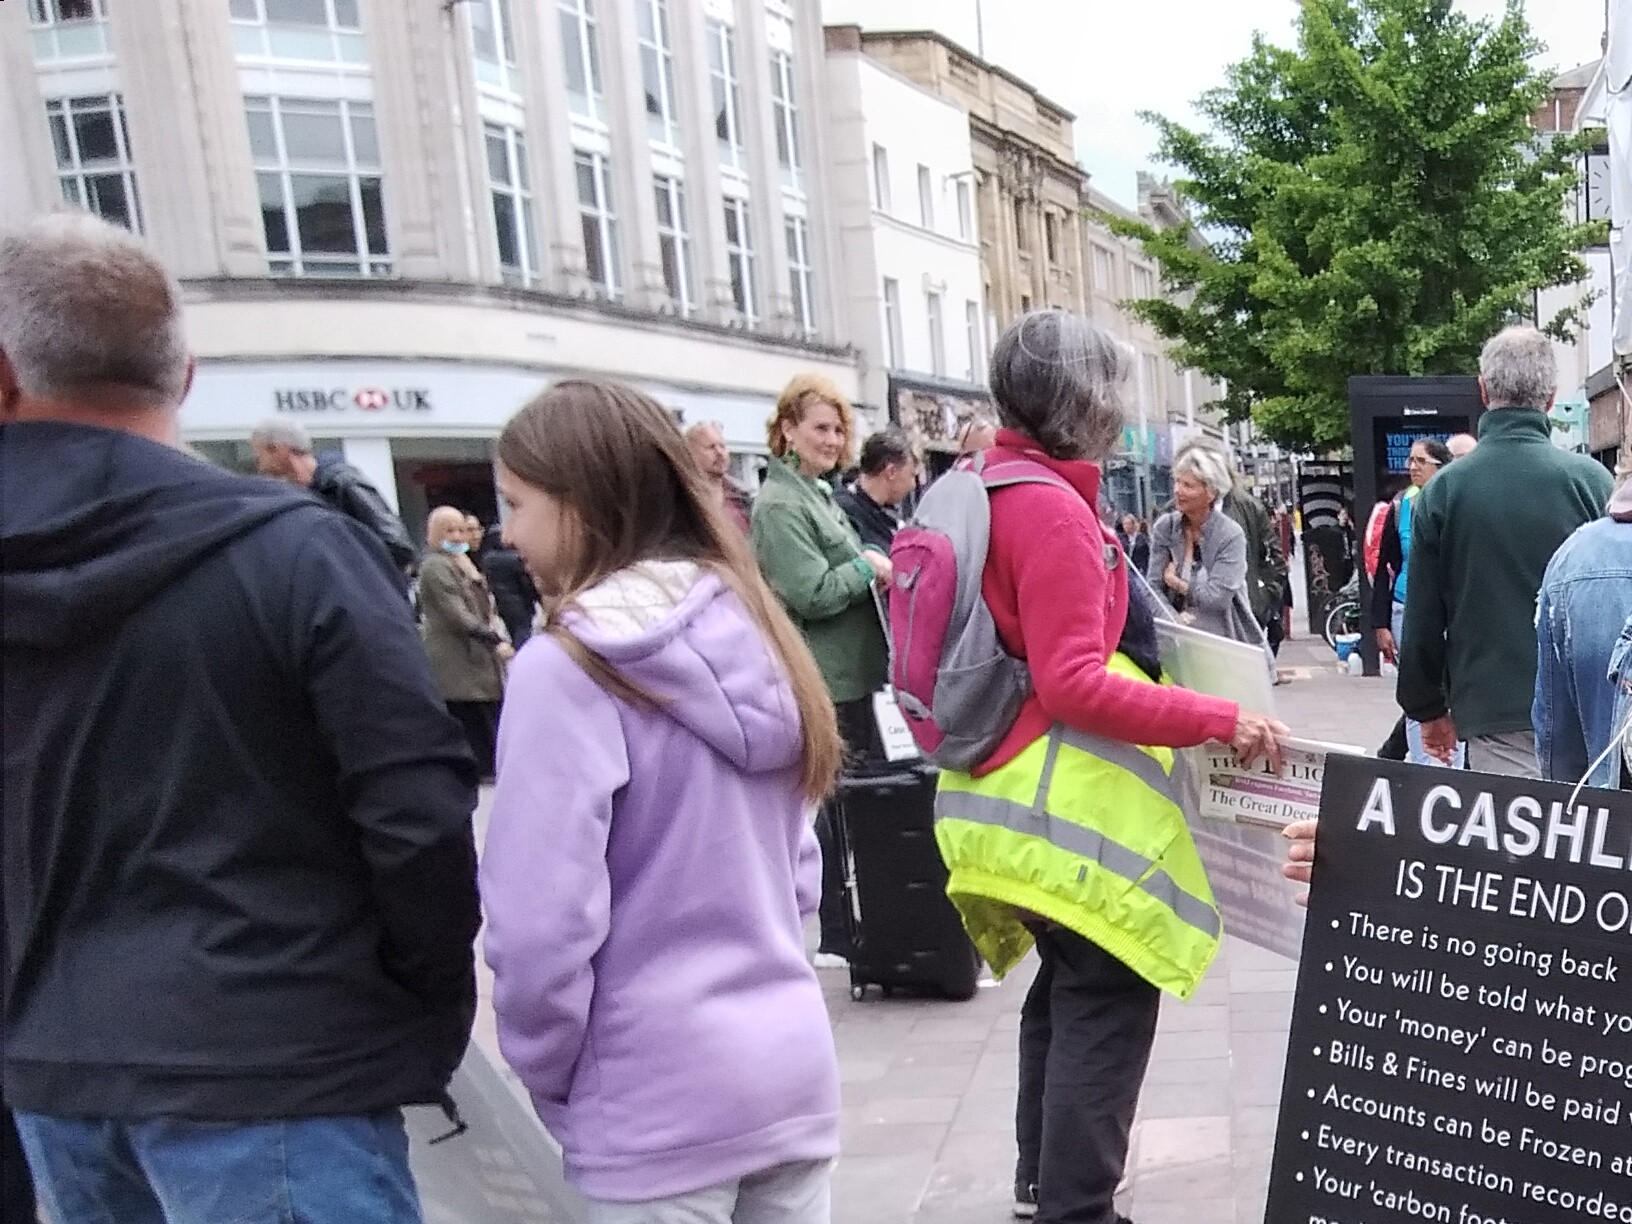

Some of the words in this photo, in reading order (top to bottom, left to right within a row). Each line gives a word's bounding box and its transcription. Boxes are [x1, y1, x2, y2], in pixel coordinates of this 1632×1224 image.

[274, 388, 347, 411] HSBC
[392, 388, 432, 411] UK
[1208, 757, 1245, 768] TH
[1209, 789, 1237, 807] The
[1239, 795, 1278, 815] Great
[1356, 777, 1397, 836] A
[1395, 858, 1425, 899] IS
[1435, 865, 1503, 912] THE
[1510, 877, 1586, 924] END
[1348, 912, 1414, 946] There
[1421, 926, 1439, 950] is
[1446, 936, 1477, 957] no
[1484, 943, 1553, 977] going
[1561, 949, 1618, 982] back
[1342, 955, 1384, 987] You
[1391, 969, 1432, 997] will
[1441, 977, 1470, 1002] be
[1478, 983, 1526, 1014] told
[1534, 997, 1595, 1027] what
[1336, 998, 1387, 1030] Your
[1394, 1009, 1487, 1052] 'money'
[1492, 1034, 1533, 1061] can
[1542, 1040, 1573, 1068] be
[1329, 1040, 1375, 1071] Bills
[1382, 1052, 1399, 1077] &
[1406, 1058, 1467, 1092] Fines
[1475, 1076, 1518, 1103] will
[1525, 1083, 1556, 1111] be
[1564, 1095, 1620, 1125] paid
[1317, 1124, 1380, 1166] Every
[1386, 1146, 1514, 1194] transaction
[1322, 1083, 1426, 1128] Accounts
[1433, 1112, 1473, 1138] can
[1481, 1119, 1511, 1147] be
[1519, 1128, 1601, 1168] Frozen
[1312, 1166, 1362, 1200] Your
[1369, 1181, 1451, 1224] 'carbon
